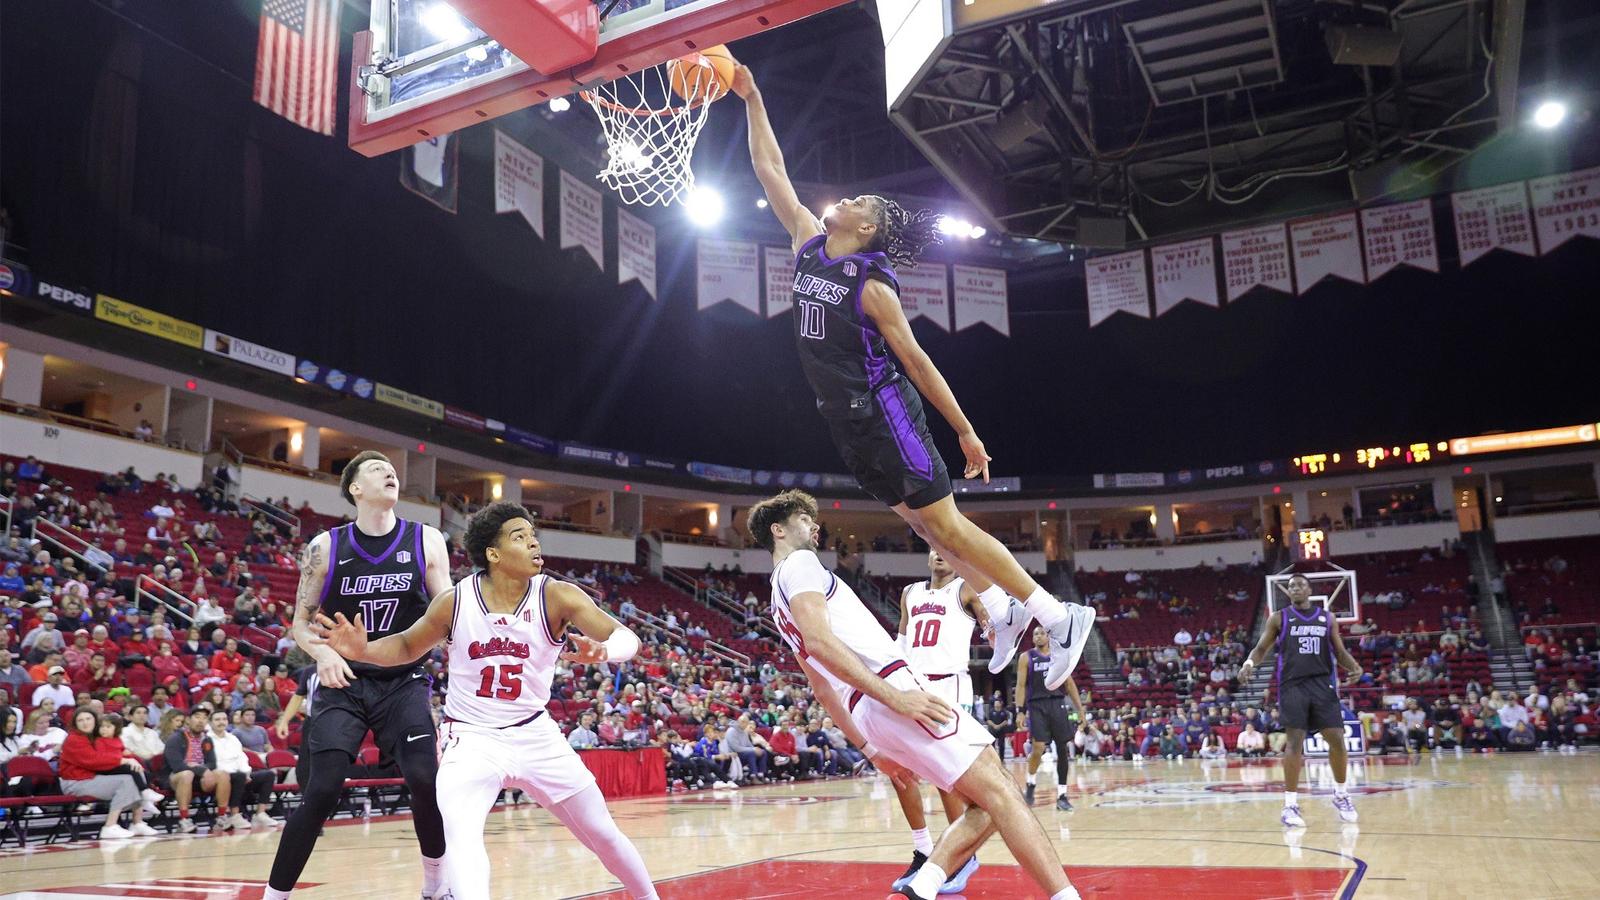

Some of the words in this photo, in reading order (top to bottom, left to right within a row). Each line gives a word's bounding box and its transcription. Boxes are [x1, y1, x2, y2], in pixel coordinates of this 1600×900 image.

[38, 281, 92, 310] PEPSI
[793, 272, 850, 305] LOPES
[799, 300, 826, 340] 10
[233, 340, 287, 367] PALAZZO
[44, 426, 59, 440] 109
[1206, 466, 1244, 480] PEPSI
[340, 573, 412, 596] LOPES
[358, 598, 399, 632] 17
[911, 602, 946, 618] Bulldogs
[912, 619, 942, 648] 10
[1290, 625, 1327, 636] LOPES
[468, 637, 530, 660] Bulldogs
[1299, 636, 1320, 654] 31
[476, 664, 524, 701] 15
